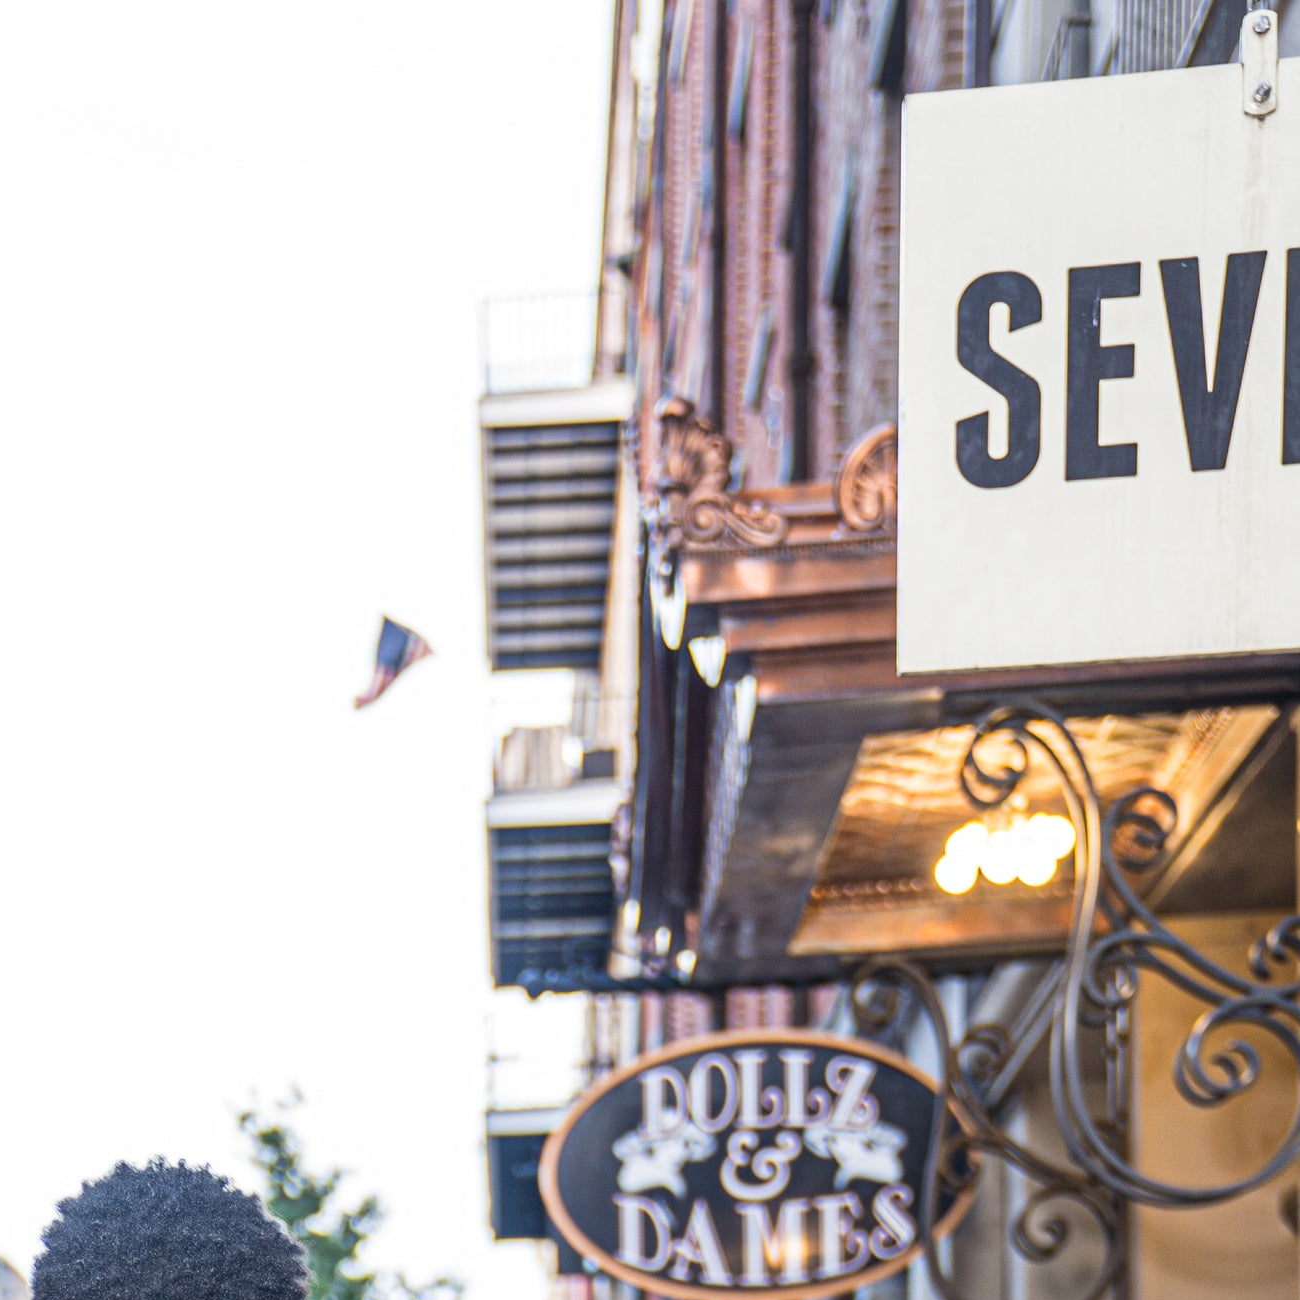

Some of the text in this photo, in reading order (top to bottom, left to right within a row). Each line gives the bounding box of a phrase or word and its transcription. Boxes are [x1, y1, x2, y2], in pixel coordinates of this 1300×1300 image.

[637, 1047, 881, 1142] DOLLZ
[719, 1129, 803, 1201] &
[612, 1184, 917, 1287] DAMES
